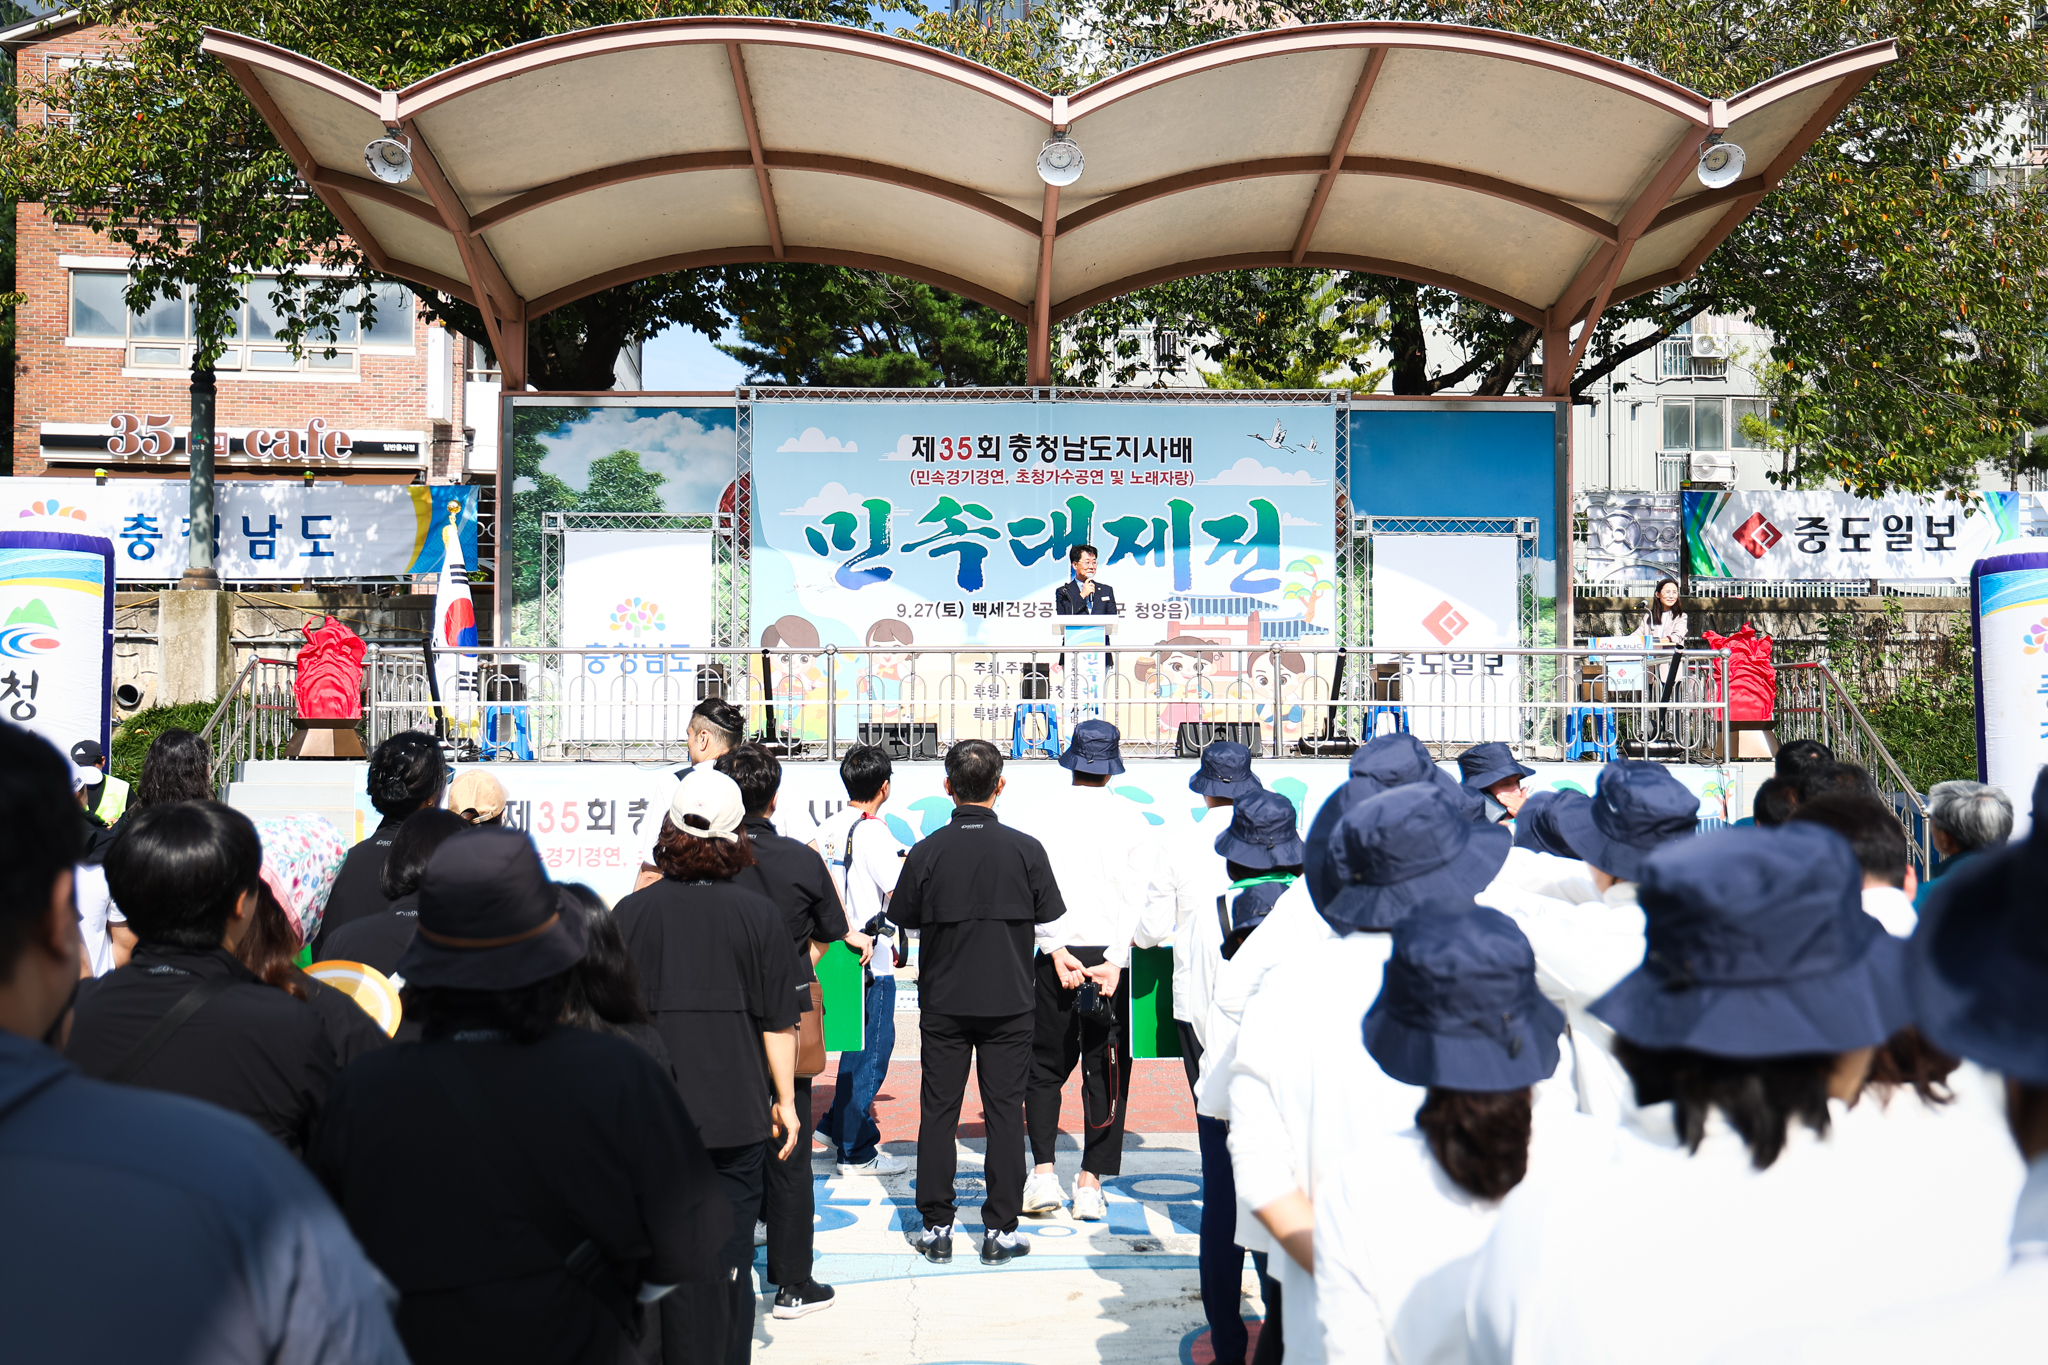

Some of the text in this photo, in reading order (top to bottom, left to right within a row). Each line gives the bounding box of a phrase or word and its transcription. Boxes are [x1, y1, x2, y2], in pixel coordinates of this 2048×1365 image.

[107, 413, 174, 457] 35
[245, 417, 353, 459] cafe
[911, 432, 1193, 464] 제35회 충청남도지사배
[909, 468, 1195, 487] (민속경기경연, 초청가수공연 및 노래자랑)
[804, 494, 1282, 594] 민속대제전
[1794, 516, 1957, 554] 중도일보
[896, 601, 965, 619] 9.27(토)
[971, 601, 1057, 619] 백세건강공
[1134, 602, 1191, 620] 청양읍)
[540, 846, 628, 869] 경기경연,
